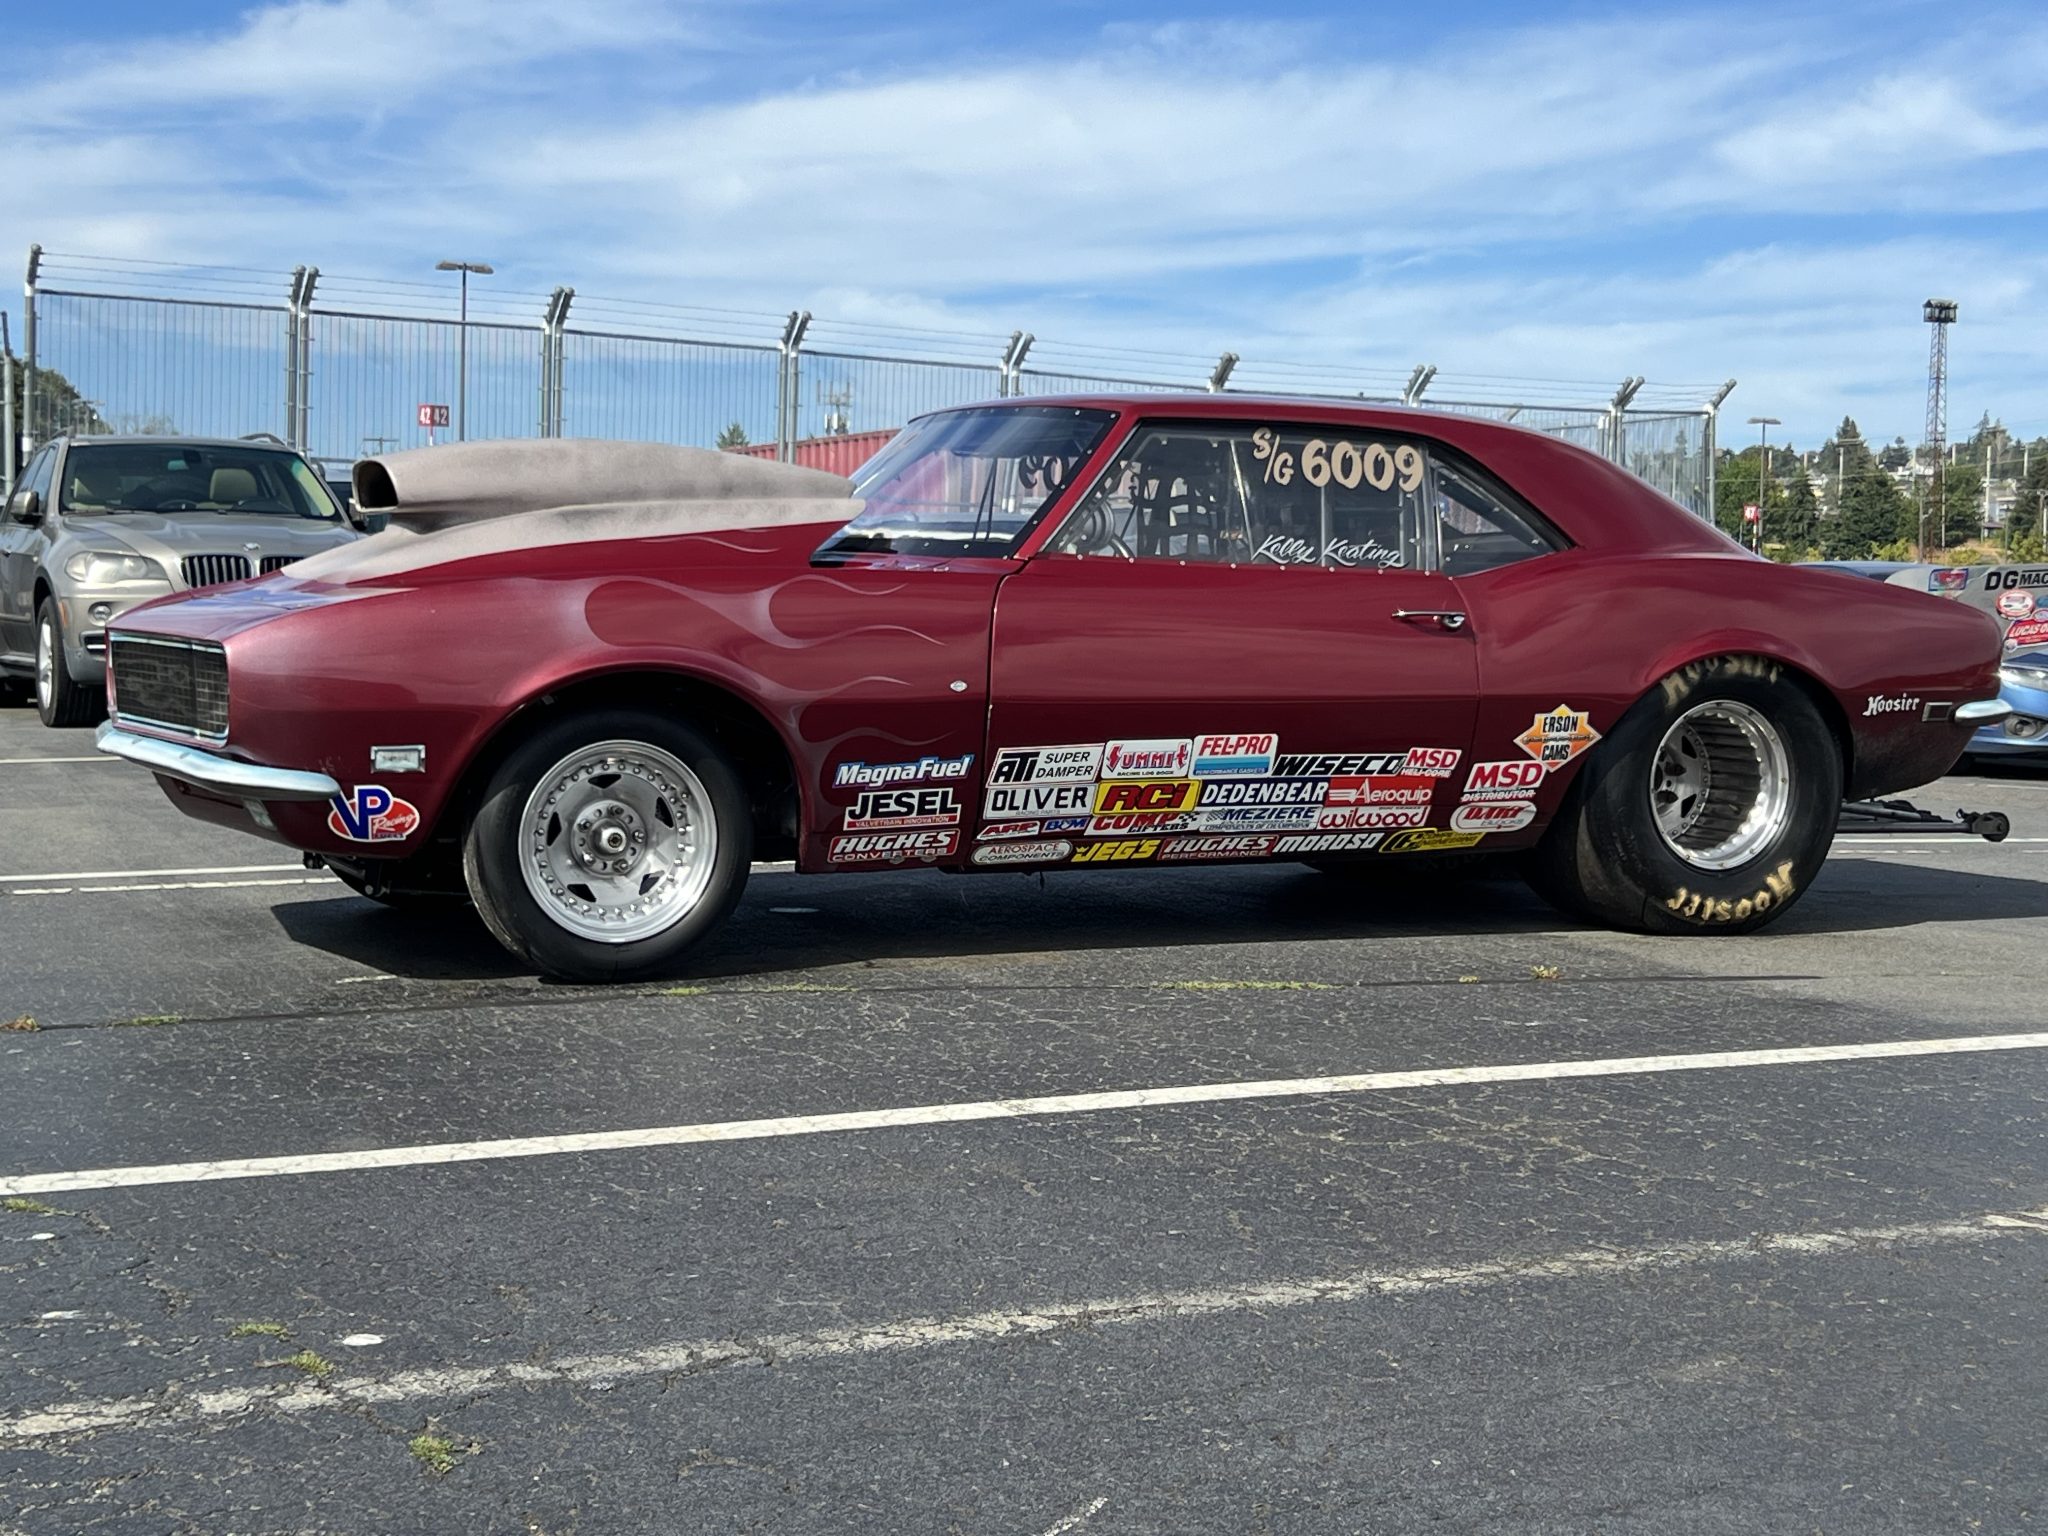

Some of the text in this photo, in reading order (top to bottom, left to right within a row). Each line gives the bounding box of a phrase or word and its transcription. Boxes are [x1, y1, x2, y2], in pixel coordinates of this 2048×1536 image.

[420, 407, 431, 425] 42
[434, 407, 448, 425] 42
[1253, 427, 1424, 492] S/G 6009
[1250, 532, 1409, 569] Kelly Keating
[1984, 571, 2019, 591] DG
[2008, 622, 2040, 638] LUCAS
[1862, 693, 1920, 716] Hoosier
[1542, 716, 1578, 733] ERSON
[1199, 736, 1272, 756] FEL-PRO
[1541, 744, 1571, 761] CAMS
[992, 751, 1040, 782] ATI
[1044, 752, 1090, 765] SUPER
[1272, 755, 1405, 777] WISECO
[1406, 749, 1458, 769] MSD
[835, 756, 972, 788] MagnaFuel
[1036, 765, 1094, 778] DAMPER
[1469, 763, 1543, 790] MSD
[991, 786, 1088, 811] OLIVER
[1201, 782, 1329, 804] DEDENBEAR
[1355, 778, 1432, 804] Aeroquip
[1461, 788, 1537, 802] DISTRIBUTOR
[330, 786, 393, 840] VP
[848, 790, 959, 819] JESEL
[1220, 806, 1318, 821] MEZIERE
[1320, 806, 1428, 829] wilwood
[833, 831, 956, 854] HUGHES
[988, 843, 1059, 855] AEROSPACE
[1163, 836, 1274, 853] HUGHES
[1272, 832, 1386, 853] MOROSO
[1162, 849, 1268, 860] PERFORMANCE
